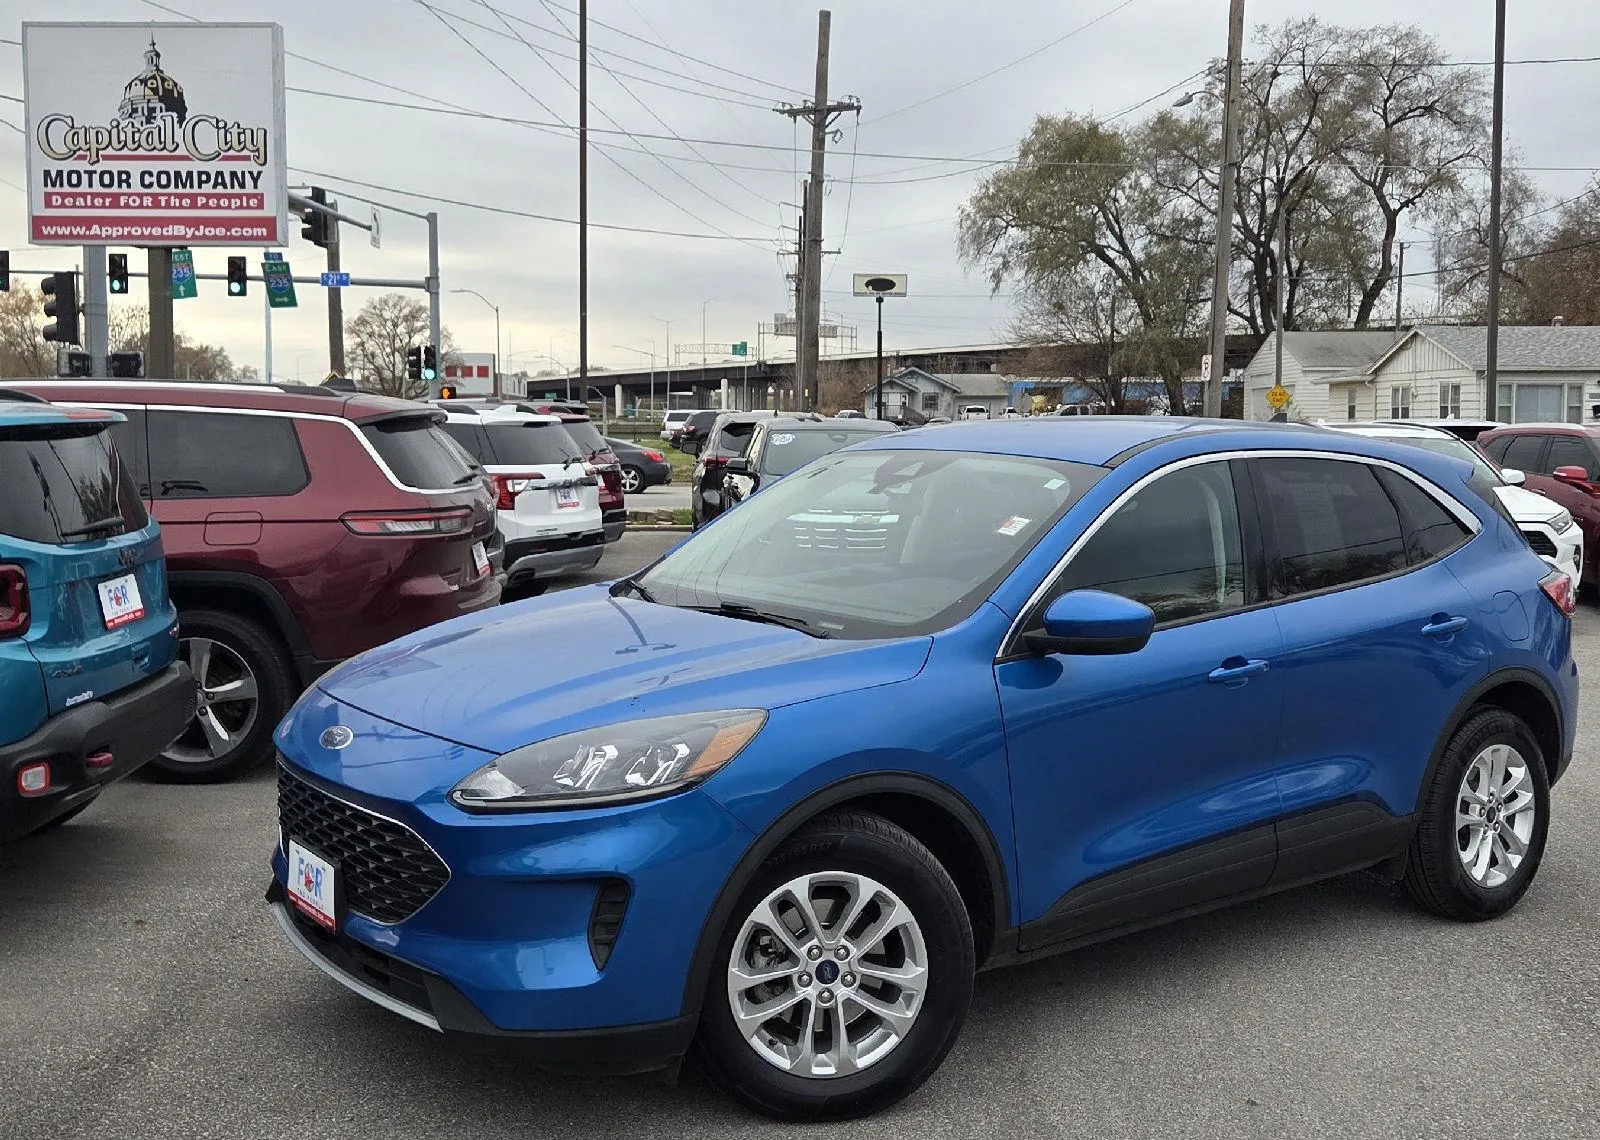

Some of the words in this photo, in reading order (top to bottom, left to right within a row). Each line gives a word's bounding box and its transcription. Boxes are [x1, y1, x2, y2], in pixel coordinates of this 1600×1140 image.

[37, 113, 180, 165] Capital
[183, 115, 268, 166] City
[43, 169, 132, 189] MOTOR
[140, 170, 263, 190] COMPANY
[52, 195, 112, 207] Dealer
[120, 195, 153, 207] FOR
[159, 195, 191, 207] The
[197, 195, 259, 210] People
[42, 223, 267, 239] www.ApprovedByJoe.com
[265, 264, 287, 272] EAST
[270, 279, 290, 288] 235
